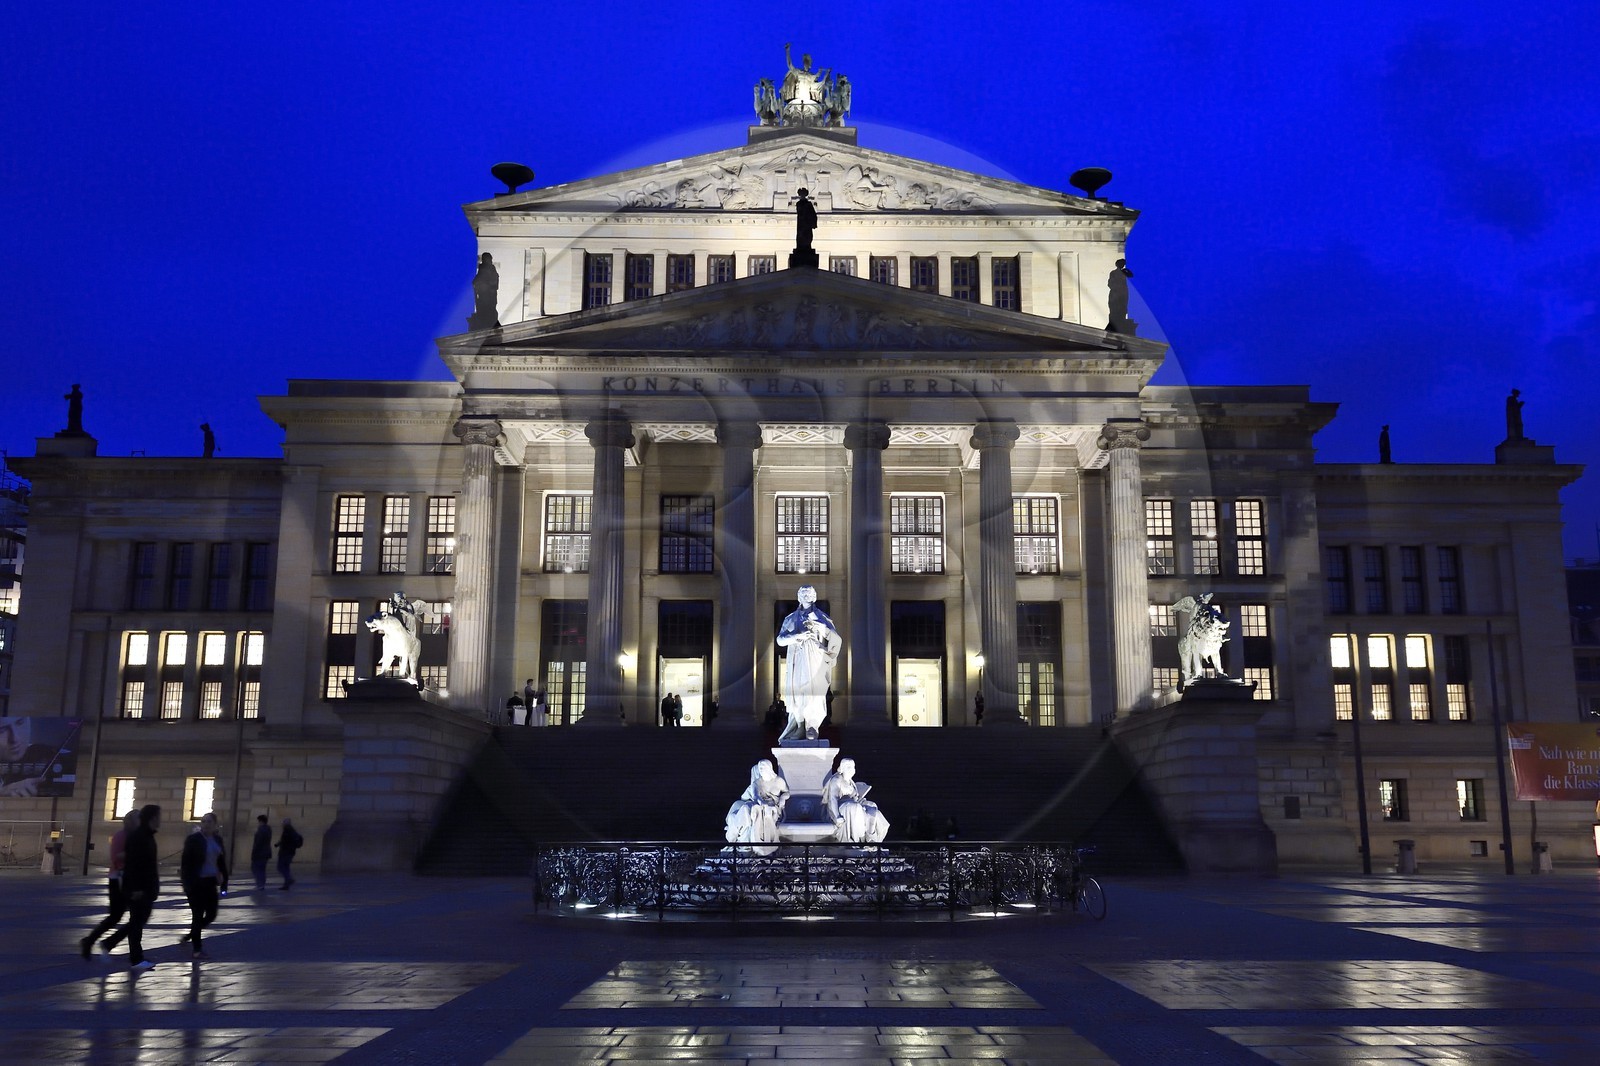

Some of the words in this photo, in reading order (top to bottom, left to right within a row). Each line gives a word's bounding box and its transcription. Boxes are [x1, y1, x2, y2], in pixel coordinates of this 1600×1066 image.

[602, 376, 847, 393] KONZERTHAUS
[879, 378, 1006, 394] BERLIN
[1539, 745, 1562, 760] Nah
[1565, 746, 1587, 760] wie
[1567, 761, 1592, 775] Ran
[1544, 775, 1561, 790] die
